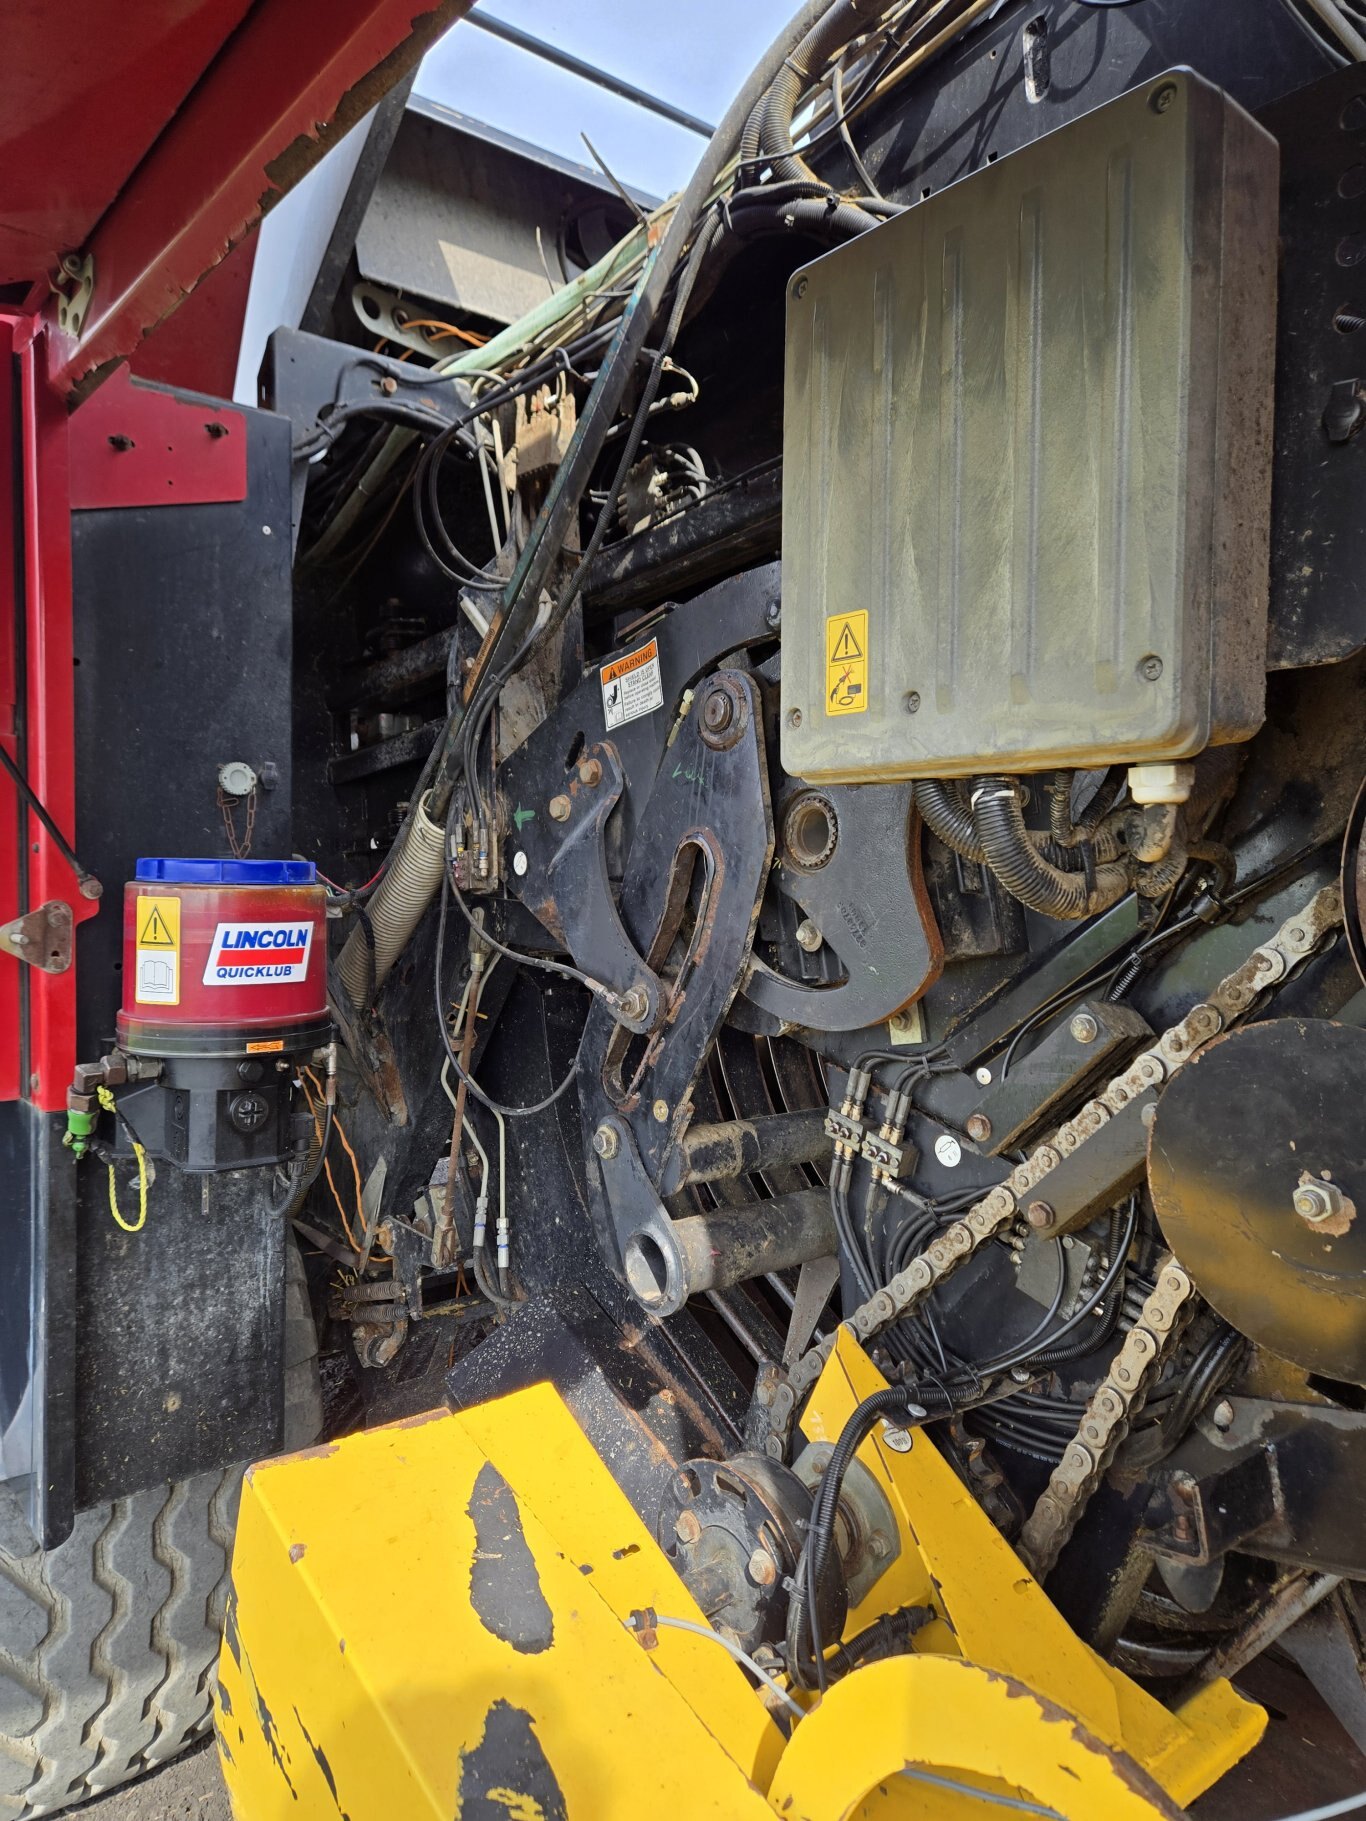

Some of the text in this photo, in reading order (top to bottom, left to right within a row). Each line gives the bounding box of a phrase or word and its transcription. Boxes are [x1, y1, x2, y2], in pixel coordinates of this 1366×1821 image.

[618, 648, 652, 673] WARNING
[628, 677, 641, 687] STAND
[221, 928, 308, 949] LINCOLN
[216, 966, 292, 979] QUICKLUB
